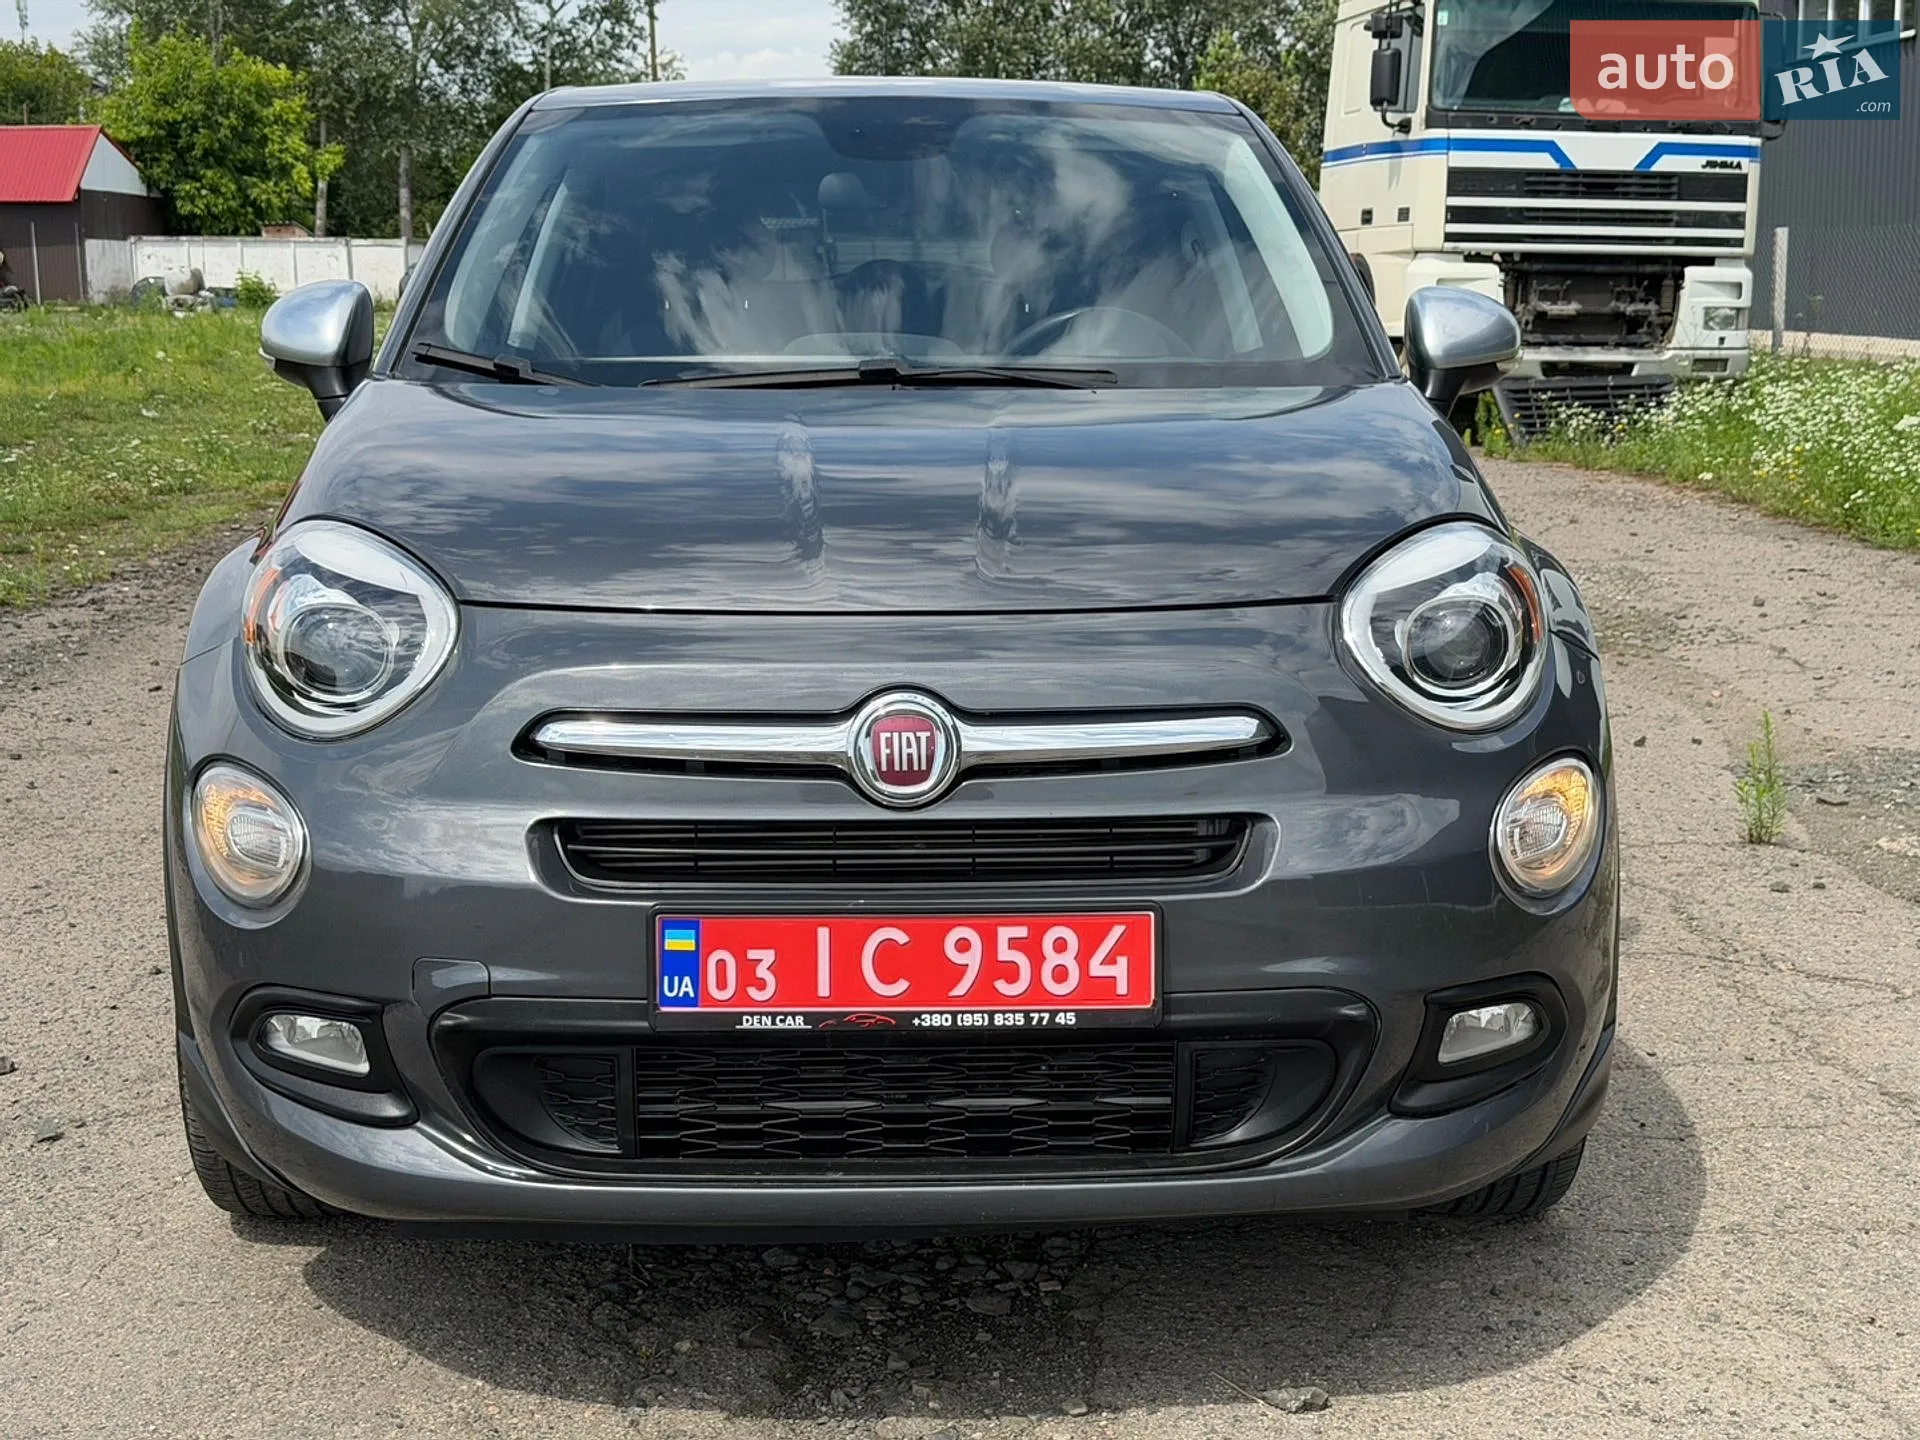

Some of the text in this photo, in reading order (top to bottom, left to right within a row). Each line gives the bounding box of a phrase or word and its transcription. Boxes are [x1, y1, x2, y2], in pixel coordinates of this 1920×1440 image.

[879, 731, 931, 772] FIAT
[706, 948, 777, 1001] 03
[943, 924, 1129, 998] 9584
[663, 976, 695, 998] UA
[742, 1015, 804, 1027] DEN CAR
[912, 1012, 1076, 1027] +380 (95) 835 77 45
